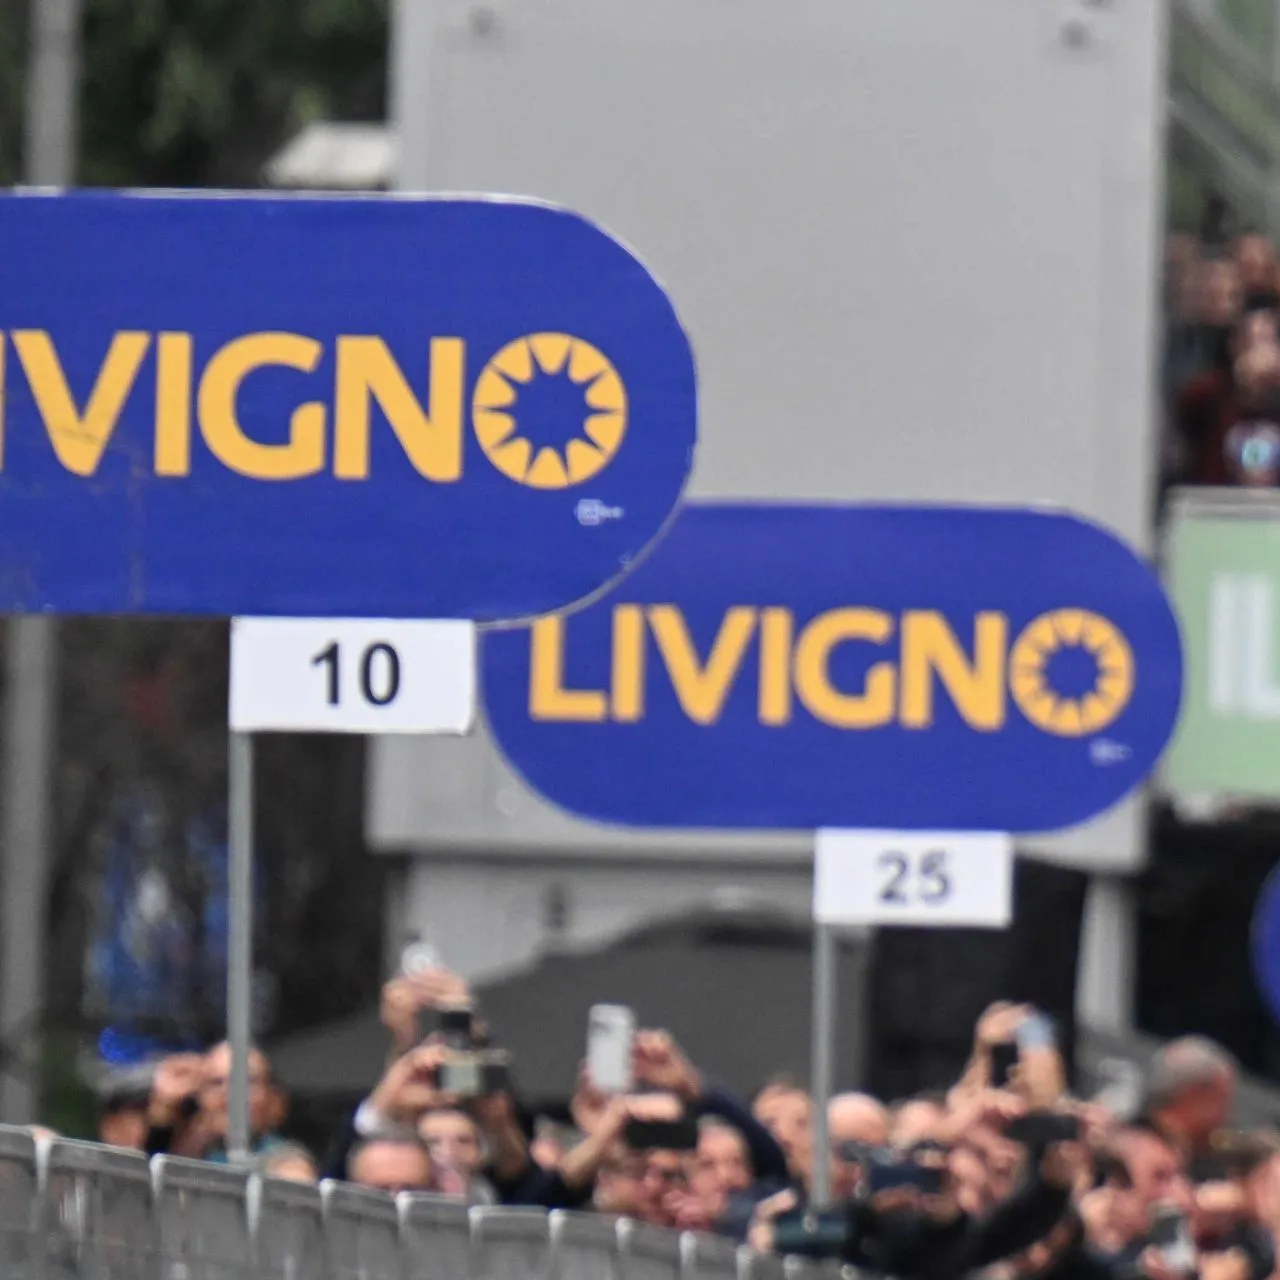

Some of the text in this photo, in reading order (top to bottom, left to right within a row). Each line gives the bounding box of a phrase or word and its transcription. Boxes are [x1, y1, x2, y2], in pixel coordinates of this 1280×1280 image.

[0, 328, 628, 490] VIGNO
[310, 642, 402, 707] 10
[877, 851, 953, 904] 25
